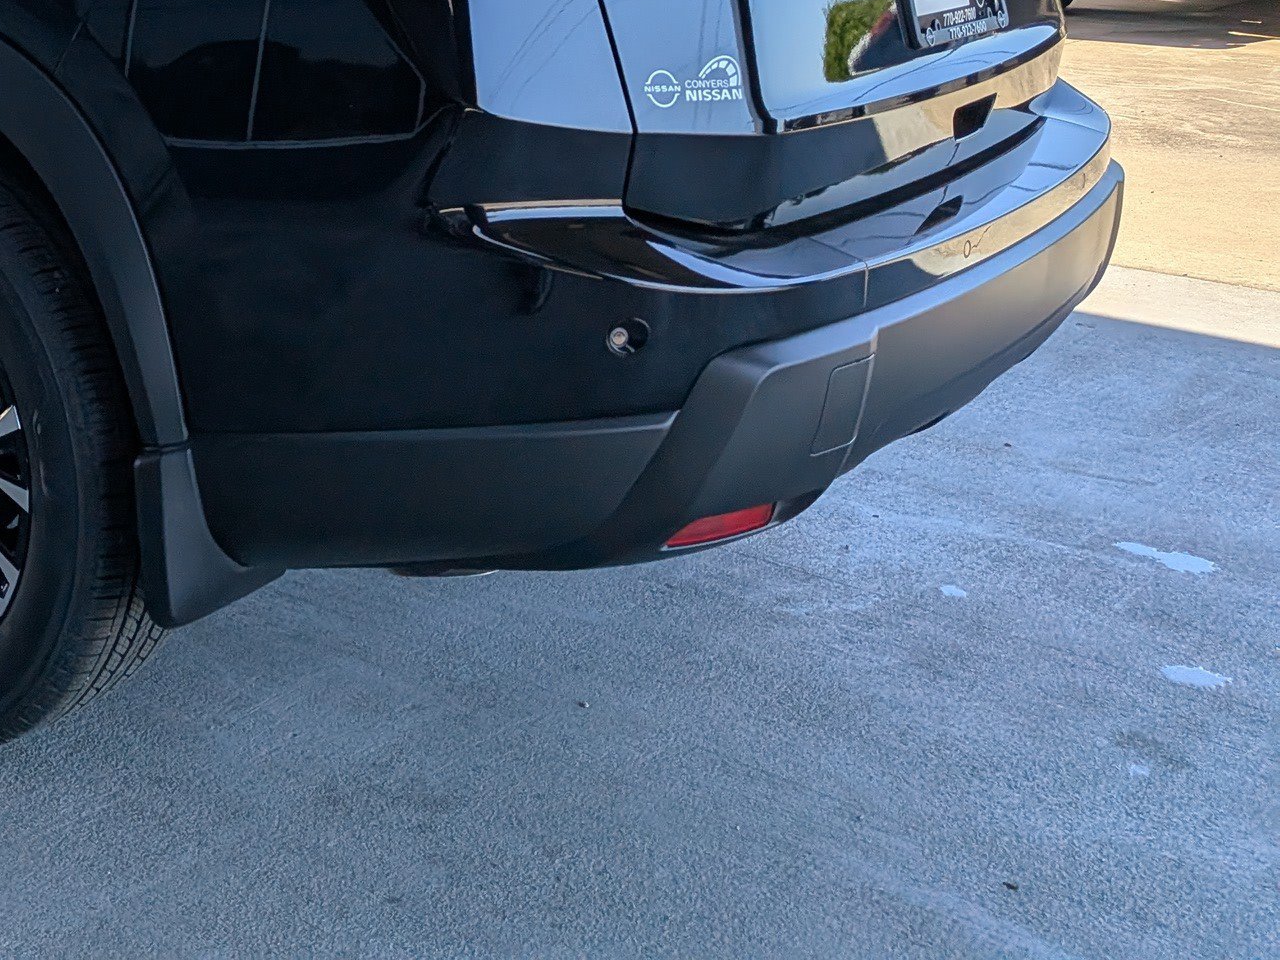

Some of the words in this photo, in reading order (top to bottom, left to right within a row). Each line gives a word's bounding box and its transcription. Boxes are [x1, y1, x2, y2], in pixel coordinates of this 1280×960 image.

[644, 85, 681, 93] NISSAN
[684, 79, 729, 89] CONYERS
[685, 89, 743, 102] NISSAN
